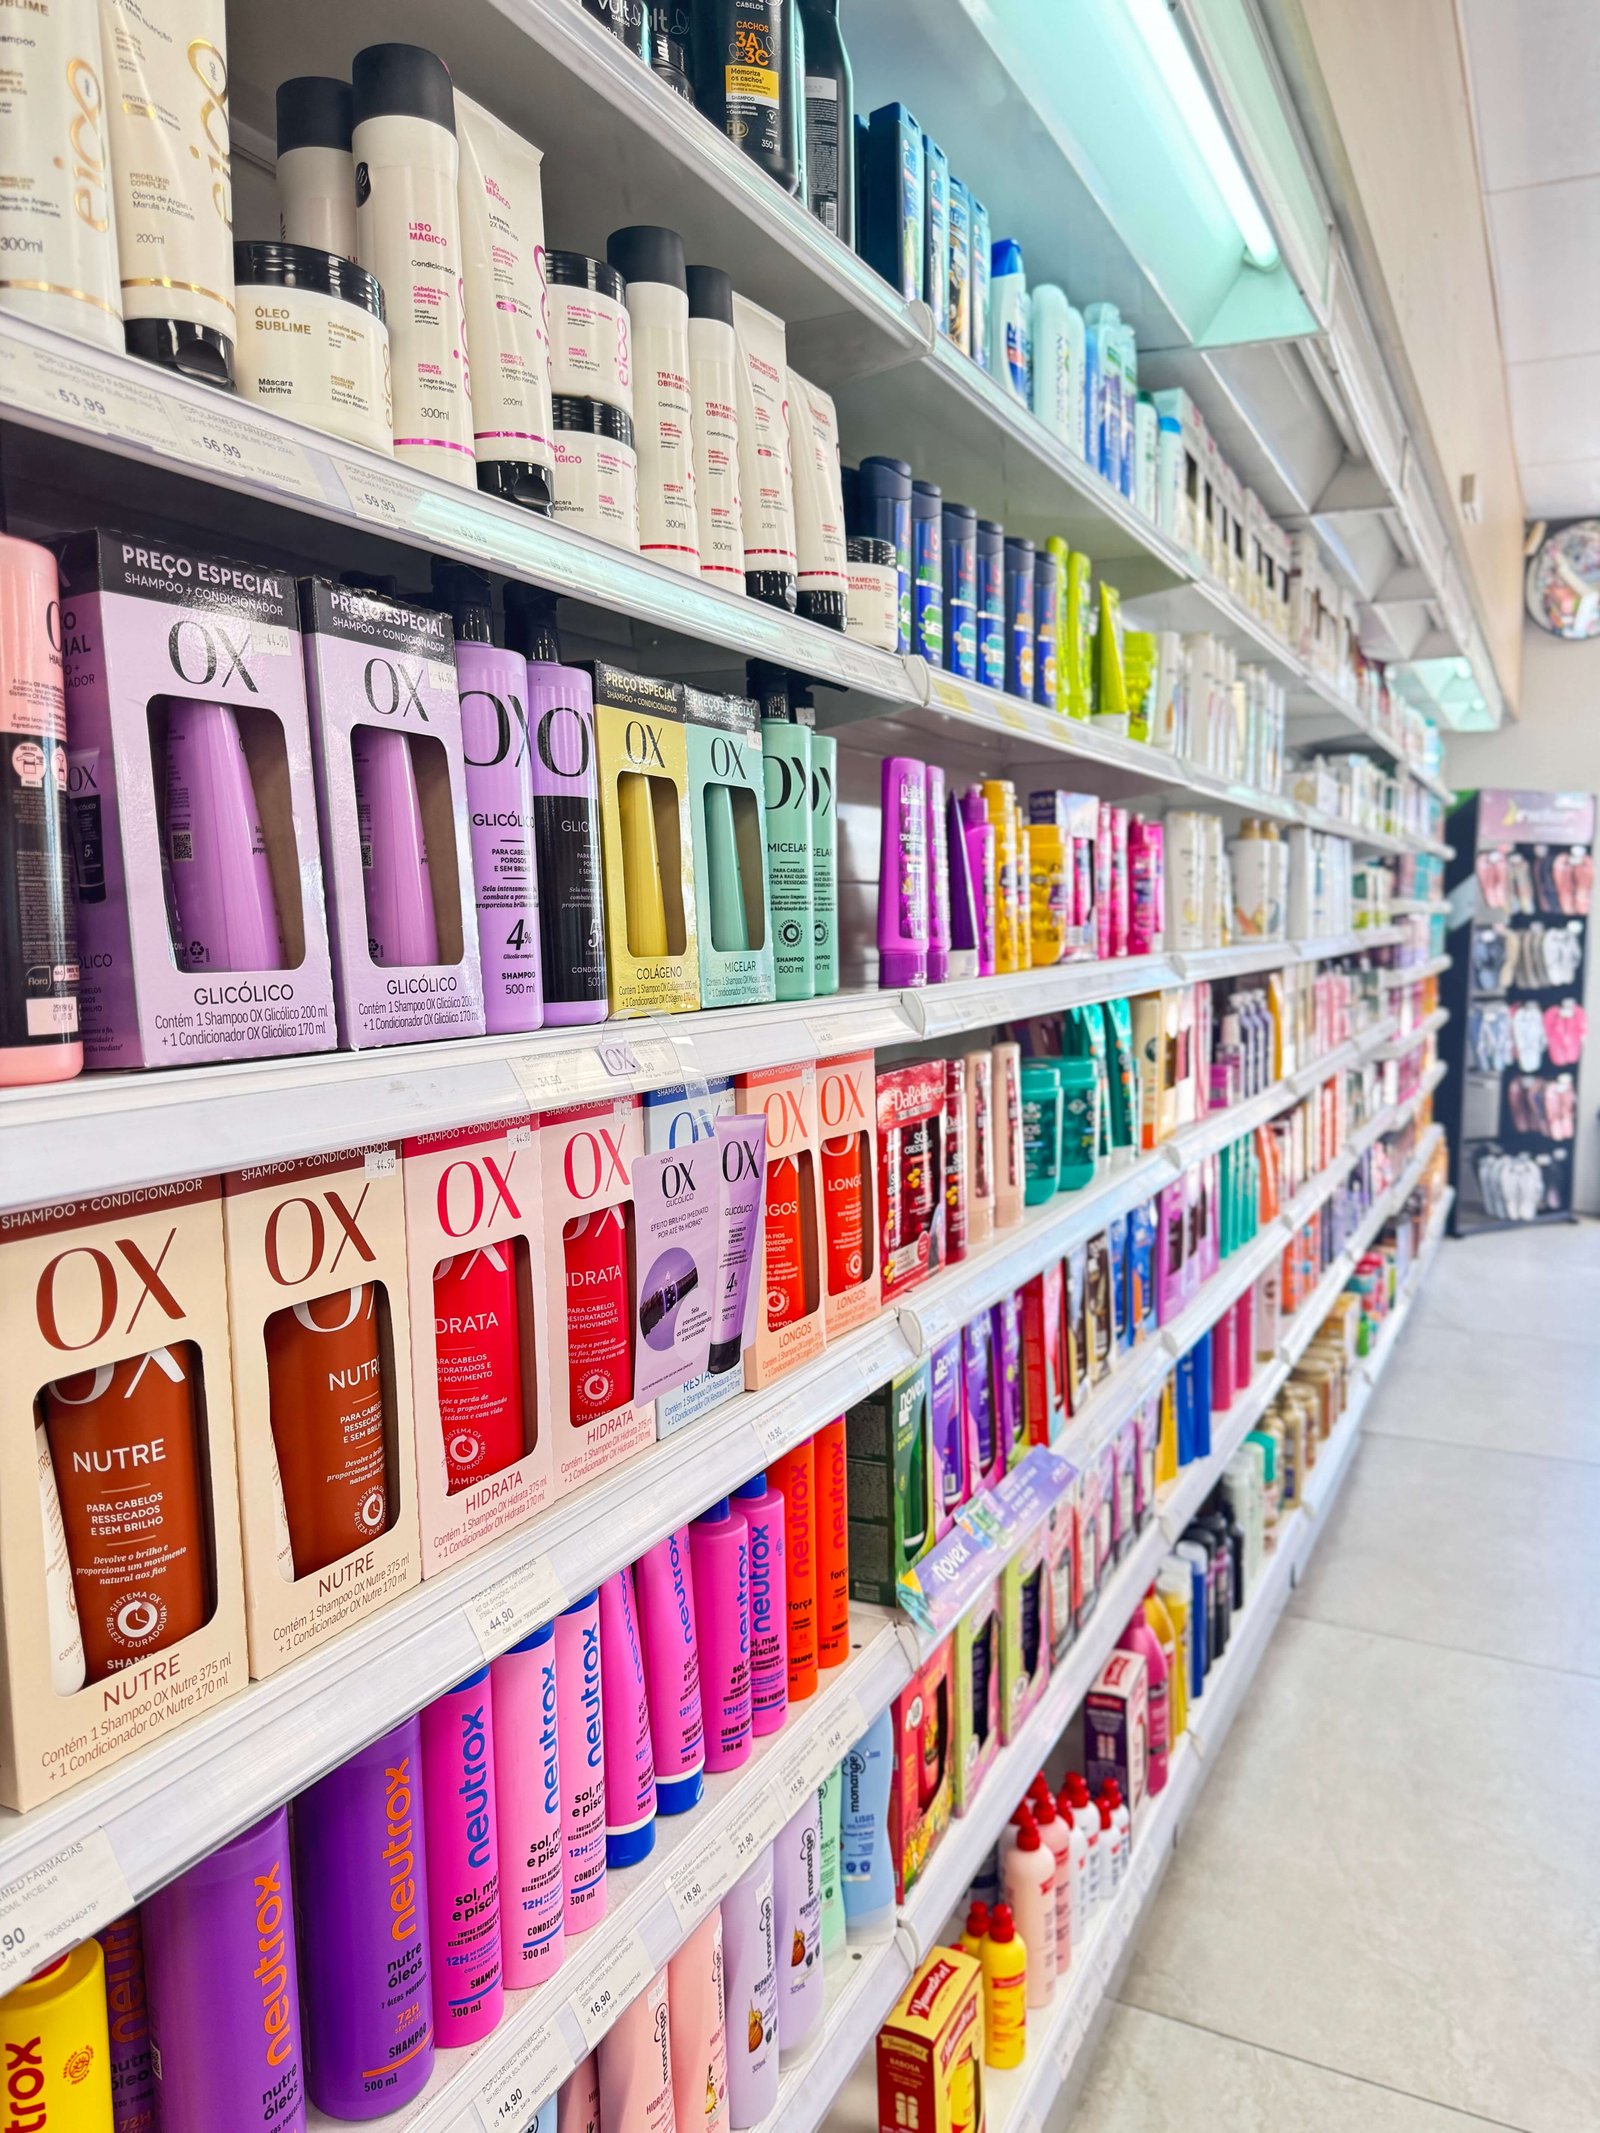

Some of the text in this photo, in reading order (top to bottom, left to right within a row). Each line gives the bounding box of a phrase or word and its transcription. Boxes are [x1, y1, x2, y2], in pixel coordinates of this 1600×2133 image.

[736, 21, 769, 33] CACHOS
[736, 32, 758, 49] 3A
[744, 49, 769, 66] 3C
[731, 67, 761, 77] Memoriza
[761, 139, 773, 149] 350
[136, 233, 165, 246] 200ml
[408, 222, 432, 232] LISO
[409, 232, 447, 247] MÁGICO
[0, 237, 43, 253] 300ml
[255, 306, 290, 320] ÓLEO
[256, 320, 311, 335] SUBLIME
[259, 377, 293, 387] Máscara
[259, 387, 292, 395] Nutritiva
[58, 389, 106, 415] 53,99
[421, 406, 449, 420] 300ml
[503, 398, 522, 407] 200ml
[202, 437, 241, 459] 56,99
[364, 494, 396, 514] 59,99
[122, 544, 283, 599] PREÇO ESPECIAL
[125, 572, 284, 616] SHAMPOO CONDICIONADOR
[168, 620, 259, 693] OX
[364, 658, 429, 722] OX
[605, 672, 677, 701] PREÇO ESPECIAL
[606, 691, 677, 714] SHAMPOO CONDICIONADOR
[460, 690, 533, 768] OX
[625, 720, 665, 768] OX
[710, 737, 746, 779] OX
[767, 842, 808, 854] MICELAR
[507, 919, 532, 951] 4%
[636, 966, 682, 980] COLÁGENO
[724, 961, 756, 973] MICELAR
[776, 956, 805, 964] SHAMPOO
[28, 977, 48, 986] Flora
[387, 975, 457, 995] GLICÓLICO
[502, 971, 536, 980] SHAMPOO
[505, 983, 535, 994] 500 ml
[194, 981, 294, 1005] GLICÓLICO
[155, 1004, 328, 1030] Contém 1 Shampoo OX Glicólico 200 ml
[820, 1071, 865, 1127] OX
[417, 1115, 531, 1145] SHAMPOO CONDICIONADOR
[764, 1087, 808, 1148] OX
[241, 1141, 389, 1181] SHAMPOO CONDICIONADOR
[563, 1123, 631, 1199] OX
[660, 1156, 674, 1164] NOVO
[722, 1139, 760, 1183] OX
[661, 1160, 696, 1199] OX
[1, 1179, 203, 1230] SHAMPOO CONDICIONADOR
[437, 1151, 522, 1237] OX
[665, 1193, 694, 1208] GLICÓLICO
[651, 1206, 709, 1232] EFEITO BRILHO IMEDIATO
[725, 1204, 753, 1217] GLICÓLICO
[264, 1183, 377, 1286] OX
[658, 1230, 668, 1239] POR
[669, 1225, 678, 1236] ATÉ
[36, 1227, 187, 1351] OX
[836, 1287, 866, 1310] LONGOS
[779, 1322, 812, 1348] LONGOS
[587, 1409, 634, 1445] HIDRATA
[72, 1438, 166, 1473] NUTRE
[86, 1492, 164, 1513] PARA CABELOS
[465, 1470, 523, 1514] HIDRATA
[91, 1505, 161, 1524] RESSECADOS
[91, 1516, 164, 1536] E SEM BRILHO
[791, 1462, 808, 1579] neutrox
[76, 1547, 187, 1577] proporciona um movimento
[93, 1553, 126, 1565] Devolve
[136, 1547, 161, 1560] brilho
[99, 1566, 167, 1586] natural aos fios
[319, 1551, 374, 1597] NUTRE
[750, 1524, 771, 1633] neutrox
[669, 1532, 693, 1644] neutrox
[788, 1597, 812, 1611] força
[489, 1608, 515, 1631] 44,90
[103, 1653, 181, 1712] NUTRE
[581, 1622, 602, 1769] neutrox
[41, 1652, 232, 1768] Contém 1 Shampoo OX Nutre 375 ml
[540, 1658, 559, 1815] neutrox
[459, 1705, 490, 1869] neutrox
[850, 1756, 862, 1813] monange
[382, 1757, 417, 1942] neutrox
[737, 1832, 755, 1854] 21,90
[26, 1841, 84, 1884] FARMACIAS
[803, 1831, 816, 1898] monange
[21, 1875, 58, 1904] MICELAR
[455, 1892, 480, 1907] sol,
[683, 1883, 702, 1905] 18,90
[522, 1899, 543, 1910] 12H
[763, 1898, 774, 1973] monange
[253, 1861, 292, 2067] neutrox
[386, 1942, 422, 1973] nutre
[446, 1953, 469, 1967] 12H
[523, 1945, 550, 1960] 300 ml
[388, 1957, 422, 1989] óleos
[470, 1962, 499, 1990] SHAMPOO
[396, 2002, 420, 2024] 72H
[450, 2003, 482, 2018] 300 ml
[590, 1990, 612, 2017] 16,90
[388, 2023, 427, 2058] SHAMPOO
[262, 2063, 297, 2104] nutre
[363, 2072, 398, 2092] 500 ml
[264, 2082, 299, 2121] óleos
[498, 2088, 523, 2118] 14,90
